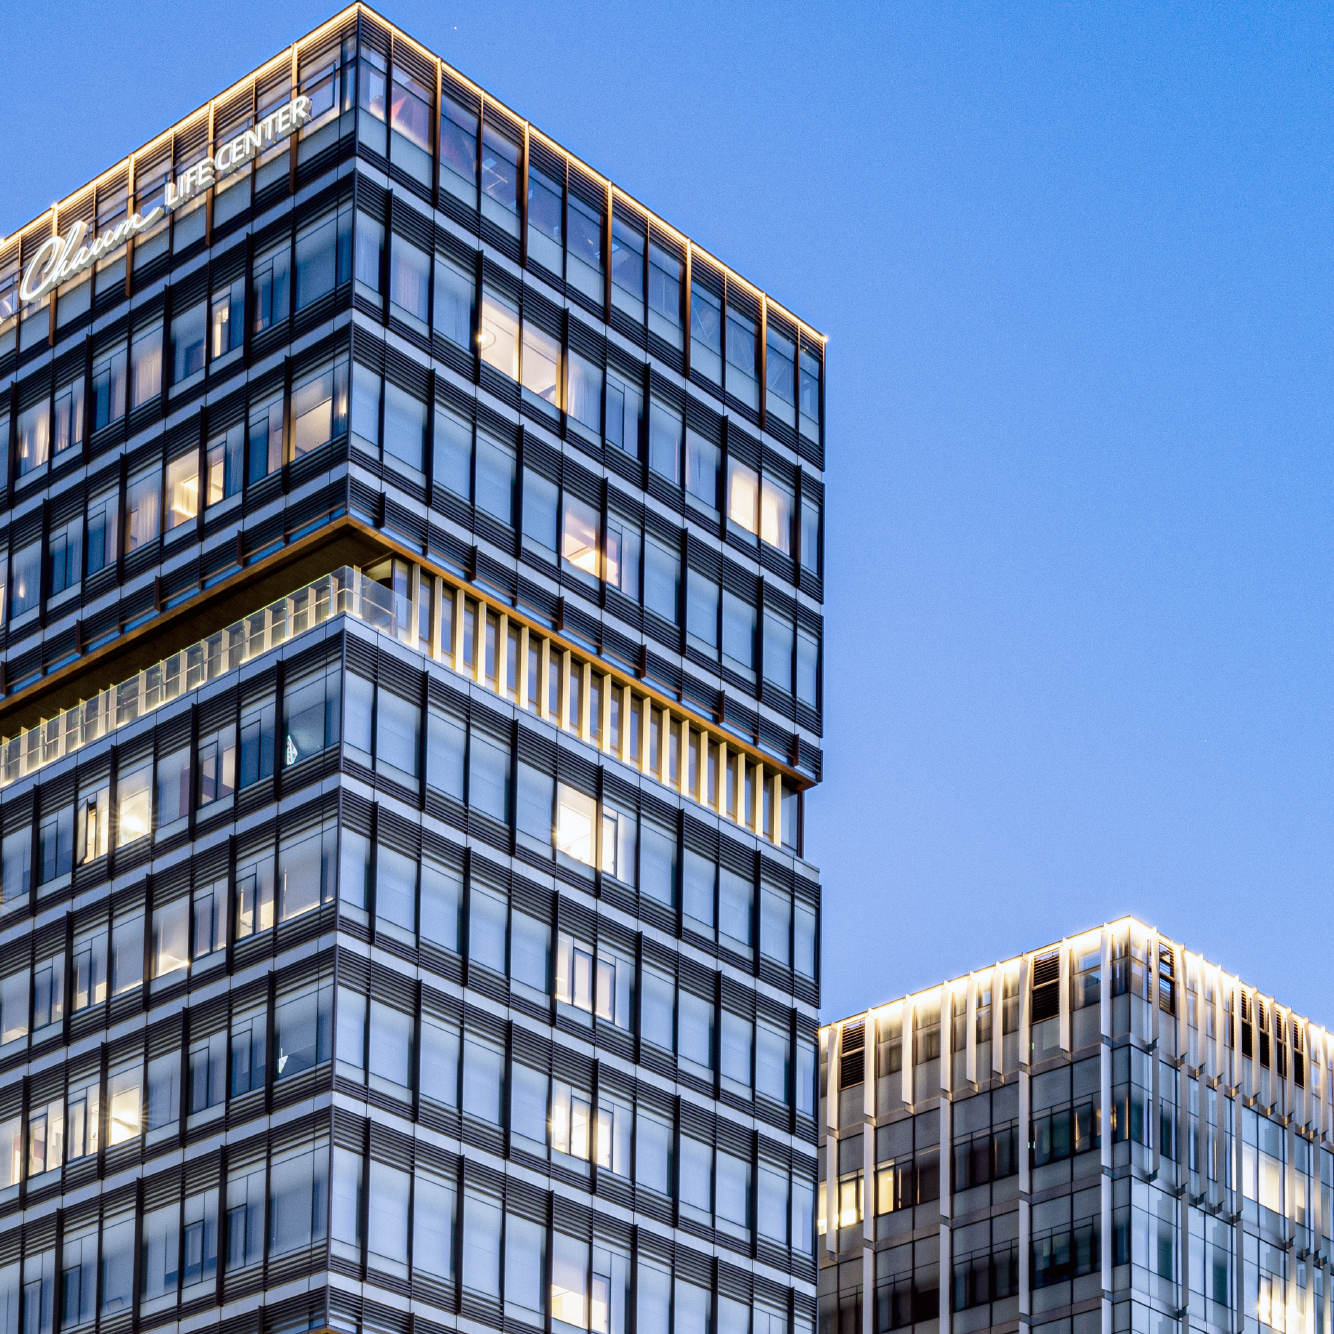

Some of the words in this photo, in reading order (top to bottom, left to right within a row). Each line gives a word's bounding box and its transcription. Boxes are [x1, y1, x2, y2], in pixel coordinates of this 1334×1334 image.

[20, 206, 164, 300] Chaum
[164, 157, 215, 210] LIFE
[214, 95, 313, 172] CENTER
